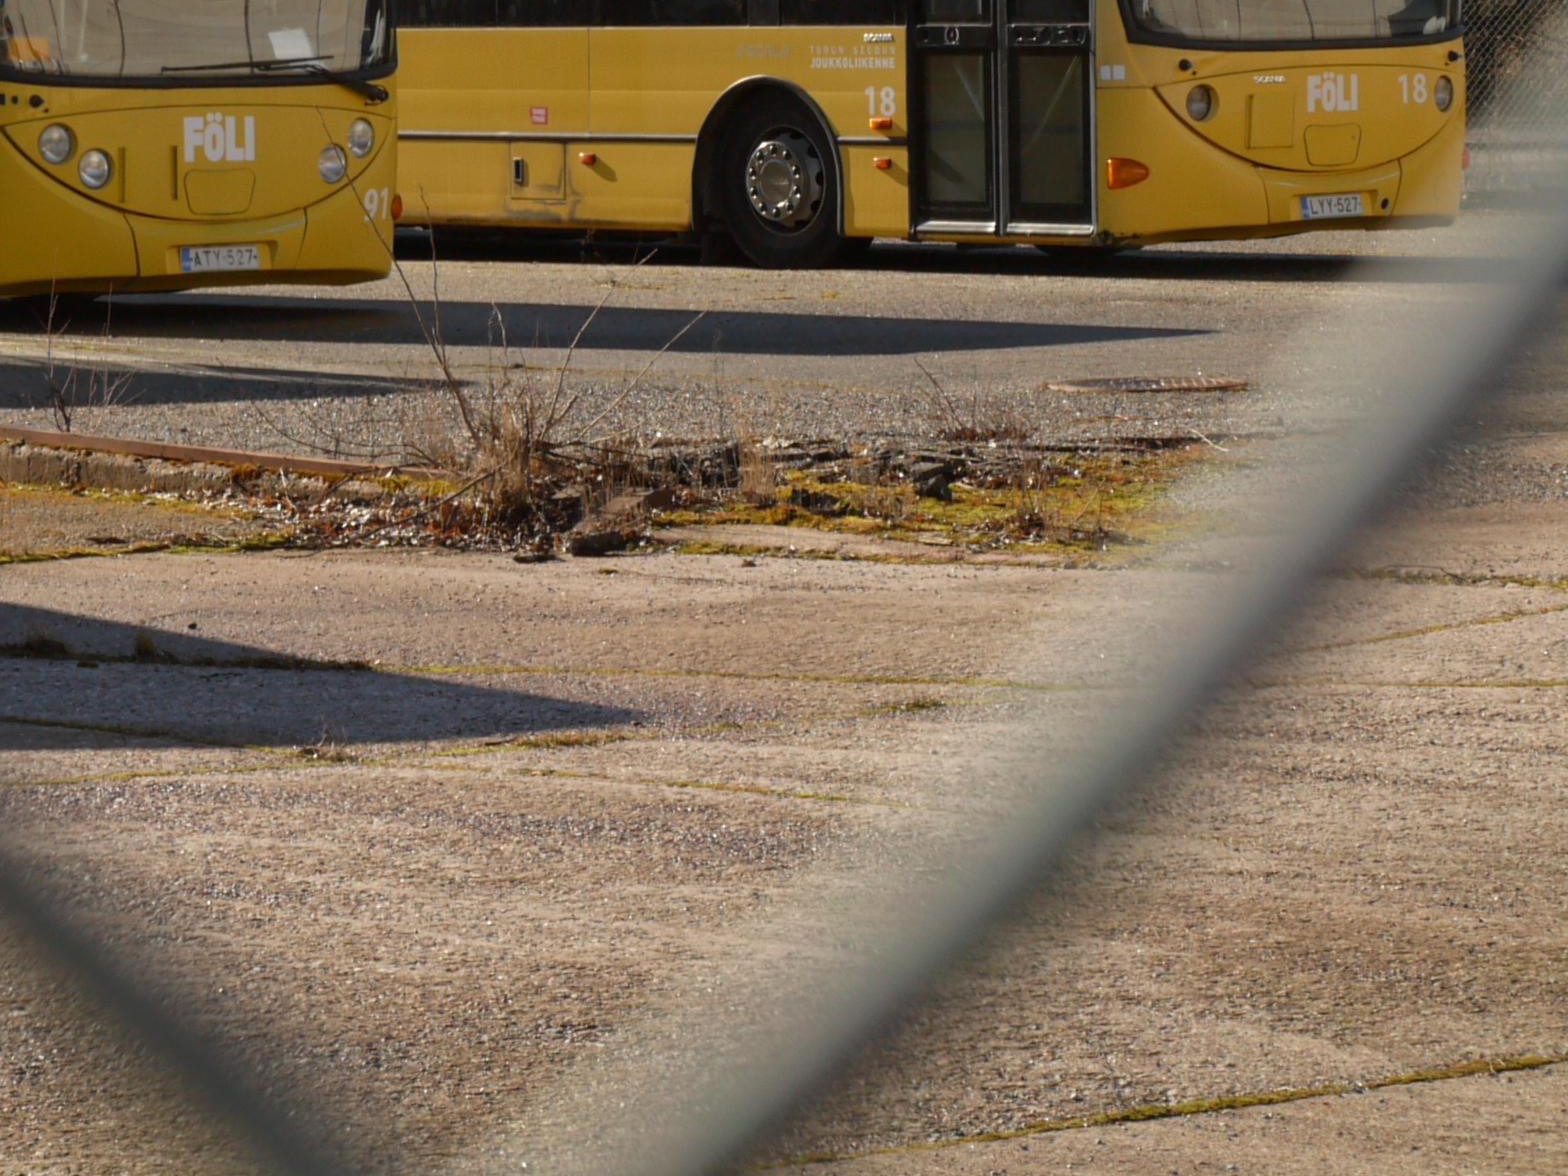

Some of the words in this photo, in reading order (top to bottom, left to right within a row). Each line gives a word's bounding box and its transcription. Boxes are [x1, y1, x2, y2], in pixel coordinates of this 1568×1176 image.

[810, 57, 896, 69] JOUKKOLIIKENNE
[865, 86, 896, 117] 18
[1307, 72, 1359, 112] FÖLI
[1398, 73, 1428, 104] 18
[183, 112, 256, 162] FÖLI
[364, 188, 389, 222] 91
[1308, 196, 1360, 215] LYY-527
[193, 249, 254, 266] ATY-527
